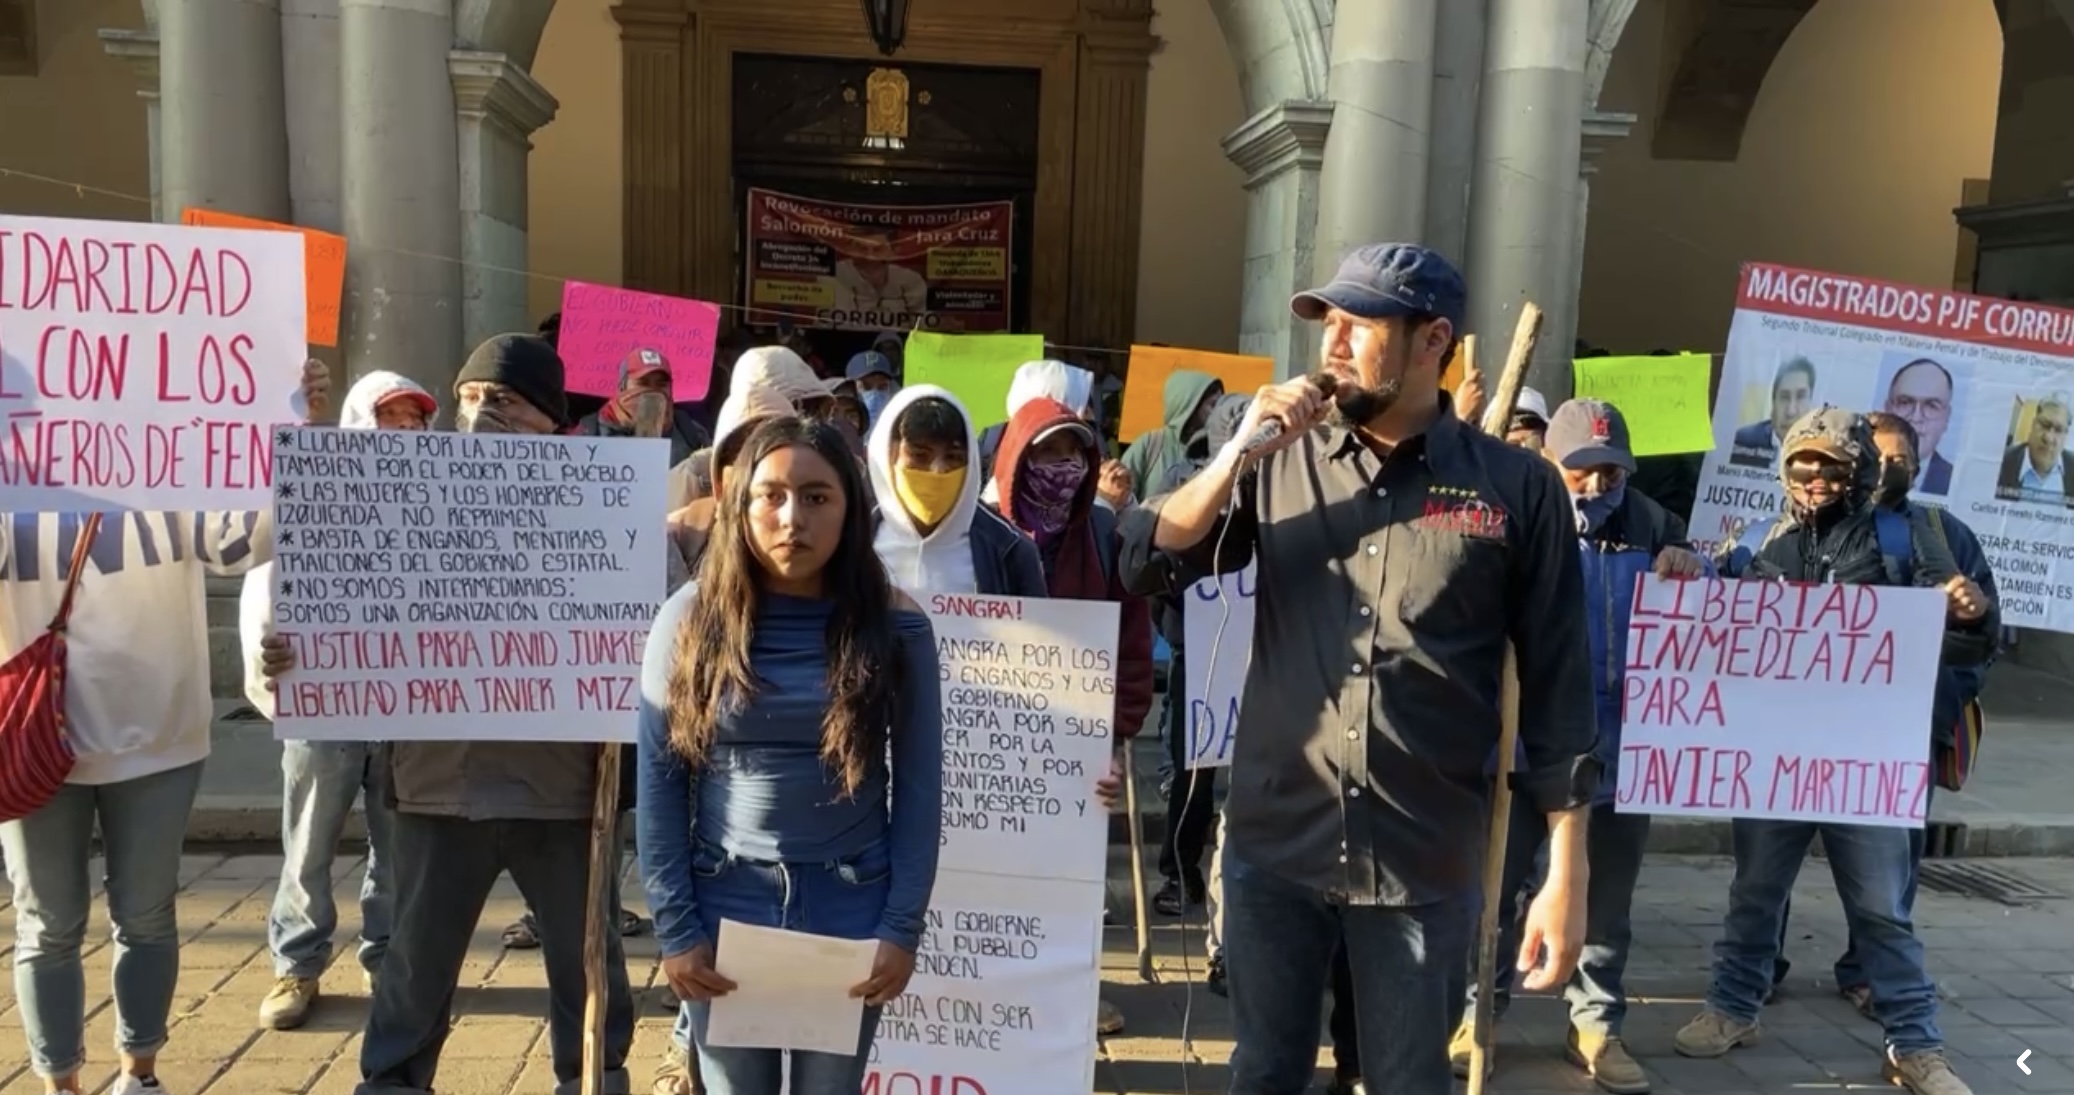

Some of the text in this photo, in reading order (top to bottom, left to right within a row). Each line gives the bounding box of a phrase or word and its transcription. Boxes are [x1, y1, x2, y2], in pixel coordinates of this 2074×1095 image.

[765, 196, 991, 225] Revocación de mandato
[761, 215, 843, 238] Salomón
[916, 227, 999, 244] Jara Cruz
[1747, 268, 1933, 324] MAGISTRADOS
[1937, 294, 1981, 330] PJF
[817, 308, 940, 328] CORRUPTO
[1762, 315, 1800, 332] Segundo
[1802, 321, 1839, 337] Tribunal
[1839, 327, 1883, 344] Colegiado
[37, 325, 129, 401] CON
[158, 332, 256, 405] LOS
[146, 424, 187, 488] DE
[416, 435, 452, 457] POR
[462, 437, 486, 460] LA
[490, 438, 571, 461] JUSTICIA
[588, 443, 598, 461] Y
[275, 455, 638, 484] TAMBIEN POR EL PODER DEL PUEBLO.
[344, 484, 429, 504] MUJERES
[438, 486, 448, 503] Y
[453, 487, 488, 505] LOS
[497, 486, 584, 507] HOMBRES
[603, 489, 632, 507] DE
[1703, 484, 1775, 512] JUSTICIA
[277, 505, 383, 526] IZQUIERDA
[402, 507, 434, 528] NO
[1719, 514, 1745, 535] NO
[374, 530, 400, 549] DE
[406, 529, 501, 551] ENGAÑOS,
[513, 531, 607, 549] MENTIRAS
[625, 529, 637, 550] Y
[2012, 538, 2029, 553] AL
[279, 553, 630, 573] TRAICIONES DEL GOBIERNO ESTATAL.
[1987, 556, 2048, 577] SALOMÓN
[332, 578, 405, 598] SOMOS
[419, 577, 575, 598] INTERMEDIARIOS:
[2056, 586, 2073, 600] ES
[276, 600, 661, 623] SOMOS UNA ORGANIZACIÓN COMUNITARIA
[931, 595, 1023, 620] SANGRA!
[1633, 571, 1879, 631] LIBERTAD
[277, 631, 408, 671] JUSTICIA
[418, 630, 484, 670] PARA
[491, 630, 558, 669] DAVID
[1022, 643, 1063, 668] POR
[1071, 648, 1111, 671] LOS
[1626, 623, 1895, 685] INMEDIATA
[961, 665, 1054, 690] ENGAÑOS
[1061, 674, 1071, 691] Y
[1082, 677, 1115, 695] LAS
[274, 677, 640, 718] LIBERTAD PARA JAVIER MTZ.
[949, 687, 1049, 712] GOBIERNO
[1621, 676, 1726, 726] PARA
[1014, 713, 1055, 734] POR
[1065, 716, 1108, 739] SUS
[989, 733, 1024, 751] POR
[1031, 738, 1055, 754] LA
[1018, 756, 1028, 773] Y
[1042, 758, 1084, 777] POR
[1617, 745, 1930, 820] JAVIER MARTINEZ
[974, 793, 1061, 816] RESPETO
[1075, 799, 1086, 818] Y
[1001, 816, 1026, 833] MI
[936, 996, 982, 1025] CON
[991, 1003, 1033, 1030] SER
[925, 1023, 948, 1046] SE
[955, 1028, 1001, 1051] HACE
